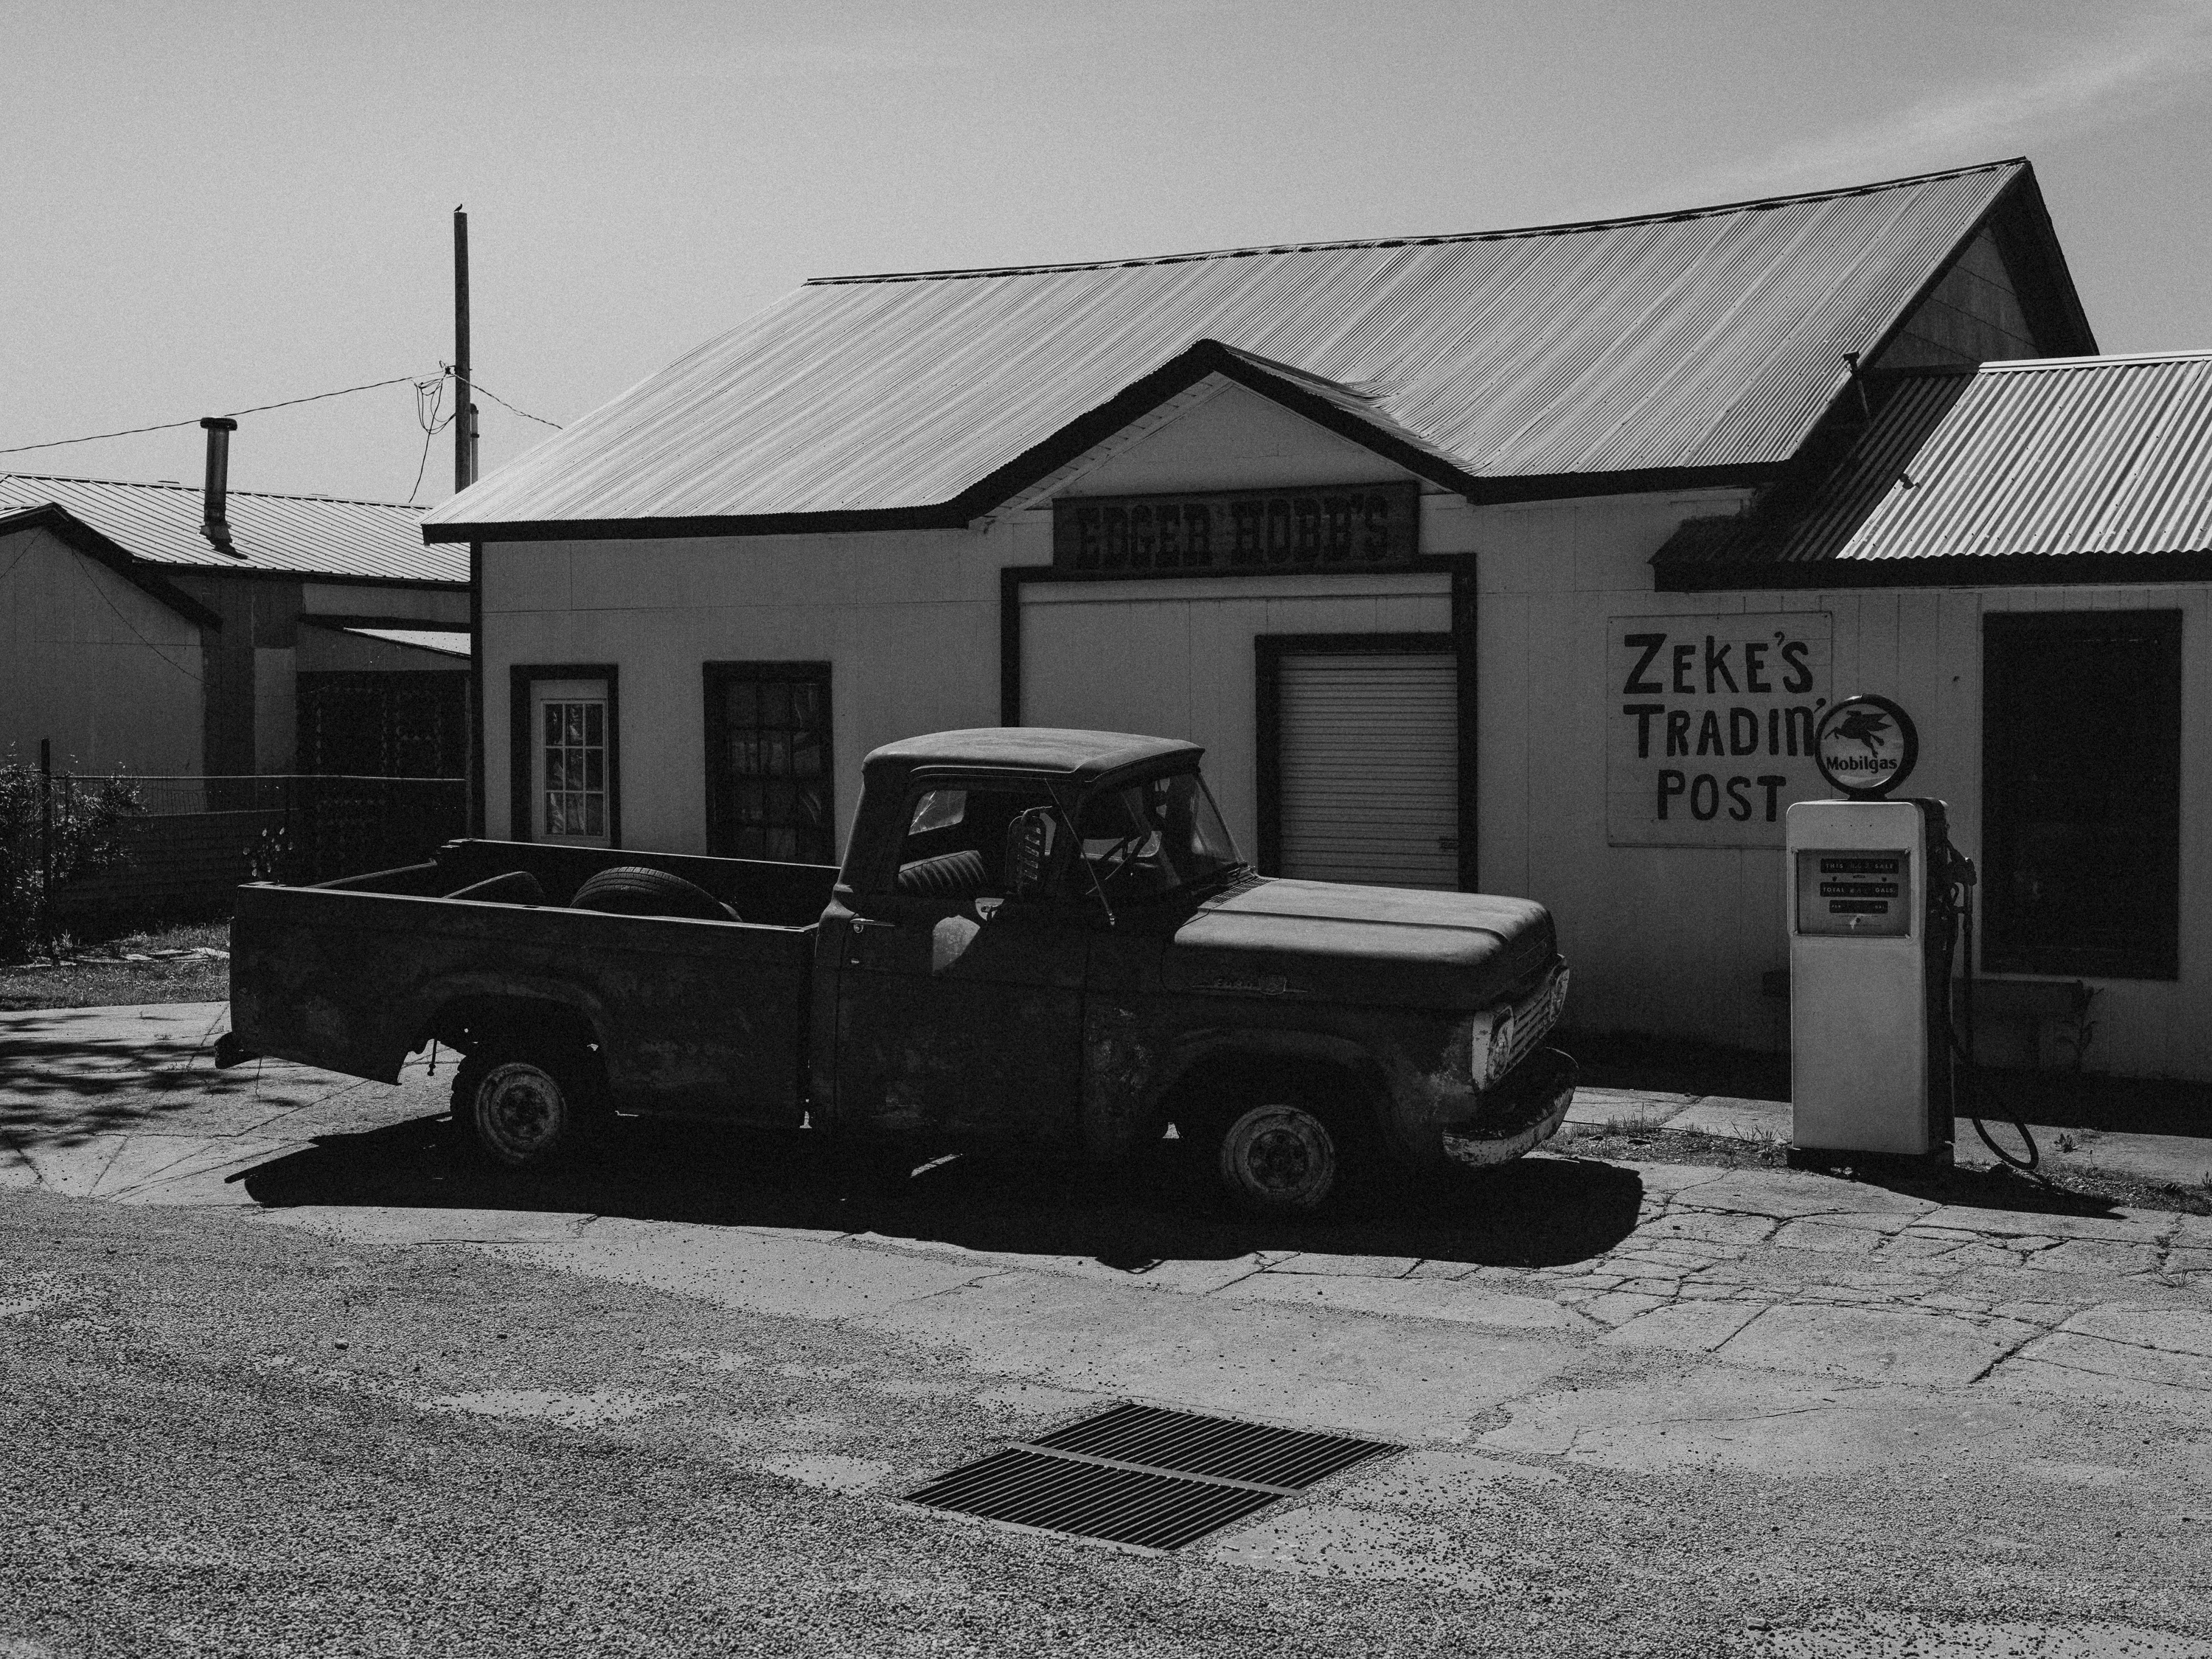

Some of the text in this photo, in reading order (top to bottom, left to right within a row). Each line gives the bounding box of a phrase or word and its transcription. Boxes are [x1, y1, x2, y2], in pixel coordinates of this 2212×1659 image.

[1624, 631, 1813, 694] ZEKE'S
[1826, 755, 1898, 774] Mobilgas
[1658, 769, 1787, 822] POST
